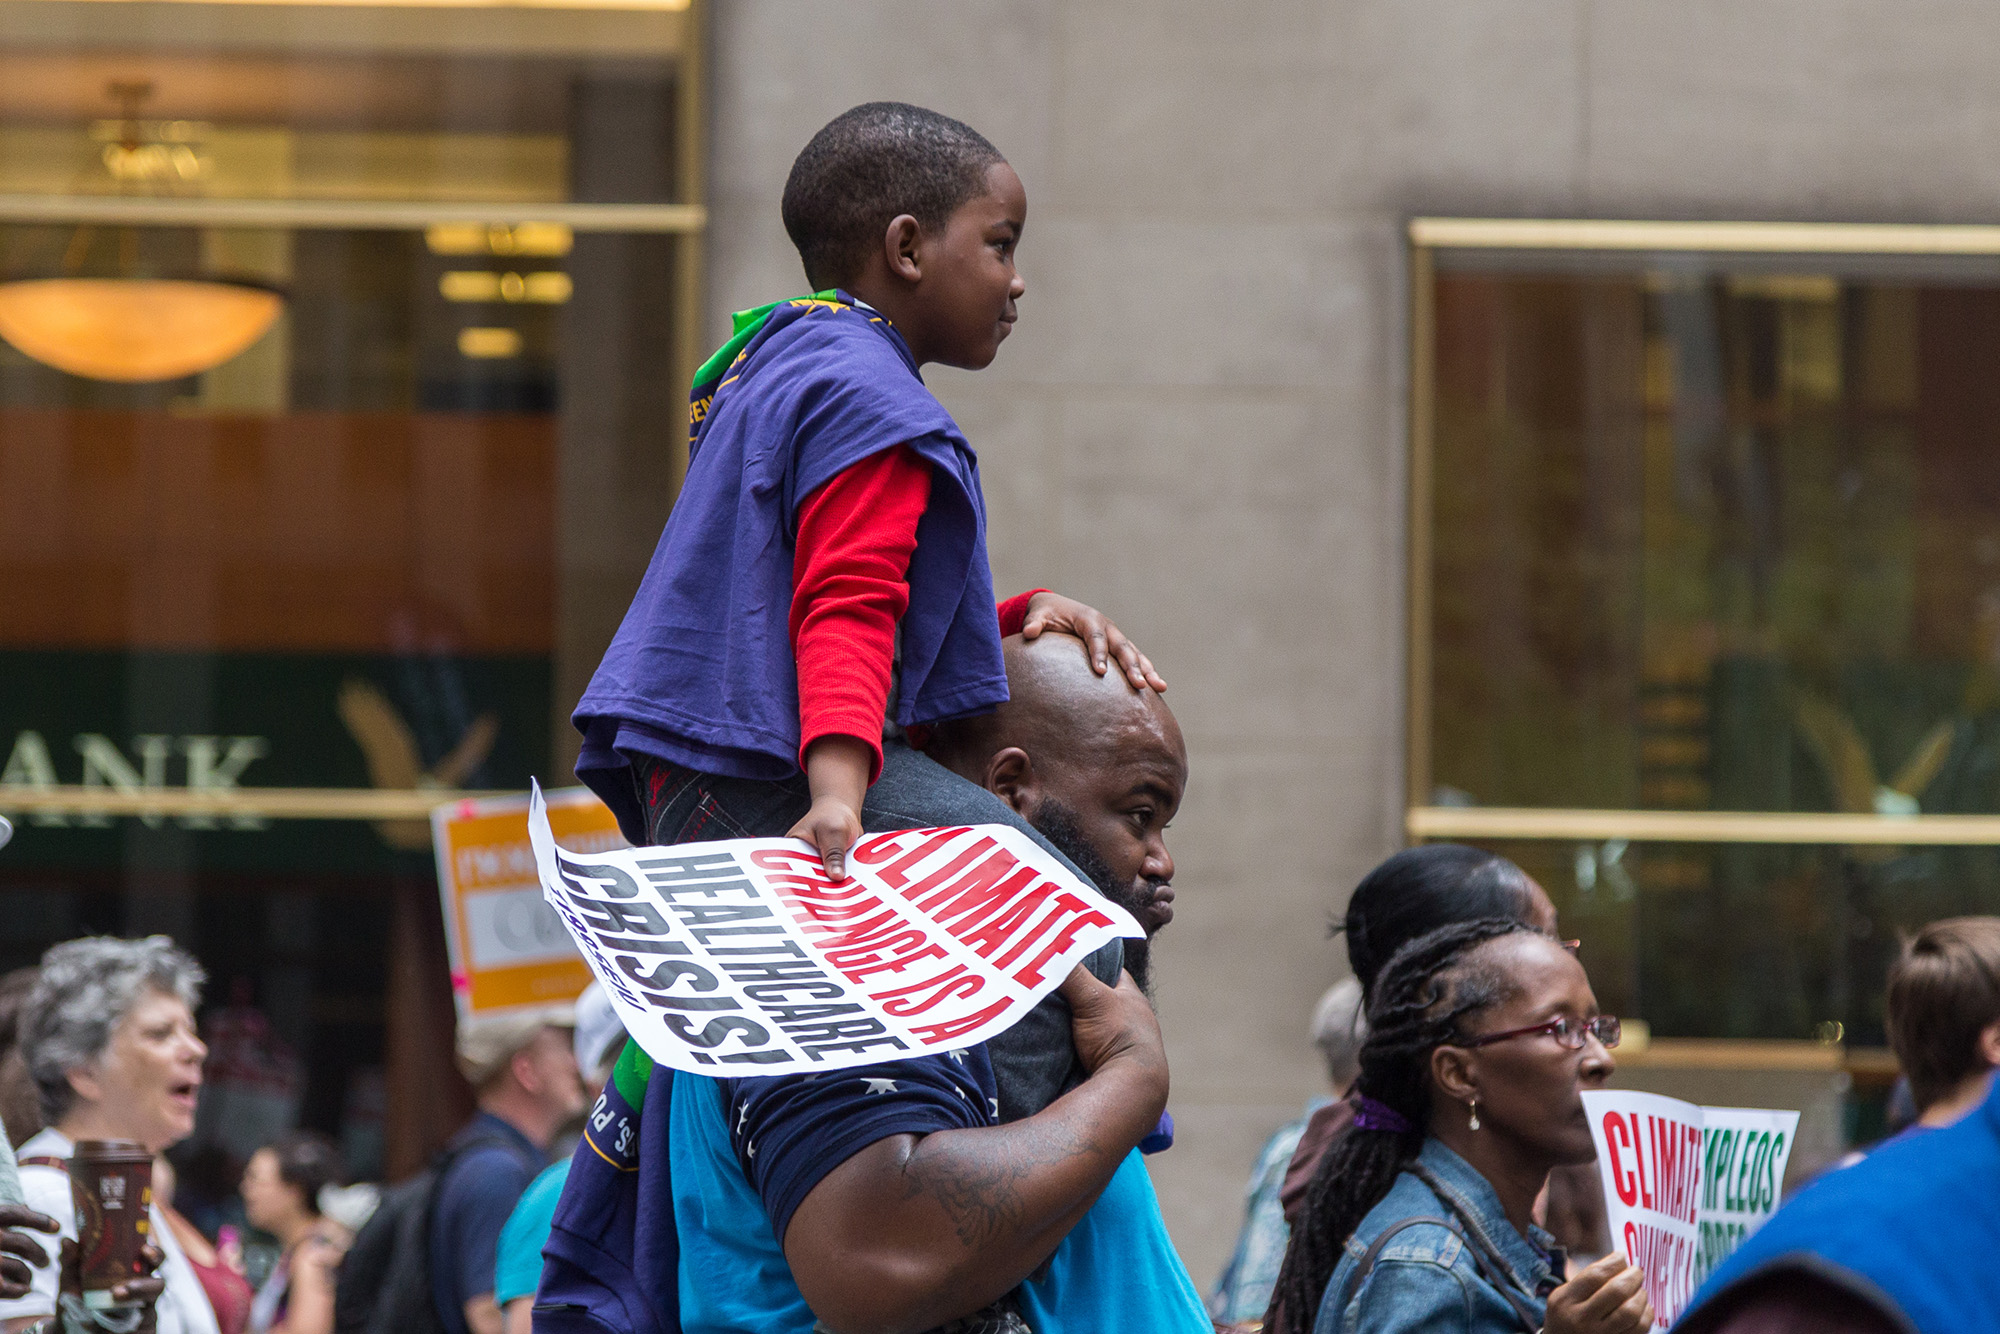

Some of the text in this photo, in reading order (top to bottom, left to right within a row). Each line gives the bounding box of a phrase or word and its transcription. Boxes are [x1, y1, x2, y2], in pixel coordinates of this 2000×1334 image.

[0, 730, 272, 832] ANK
[555, 847, 796, 1066] CRISIS!
[635, 852, 911, 1063] HEALTHCARE
[749, 849, 1015, 1046] CHANGE IS A
[853, 826, 1117, 991] CLIMATE
[1602, 1110, 1702, 1225] CLIMATE
